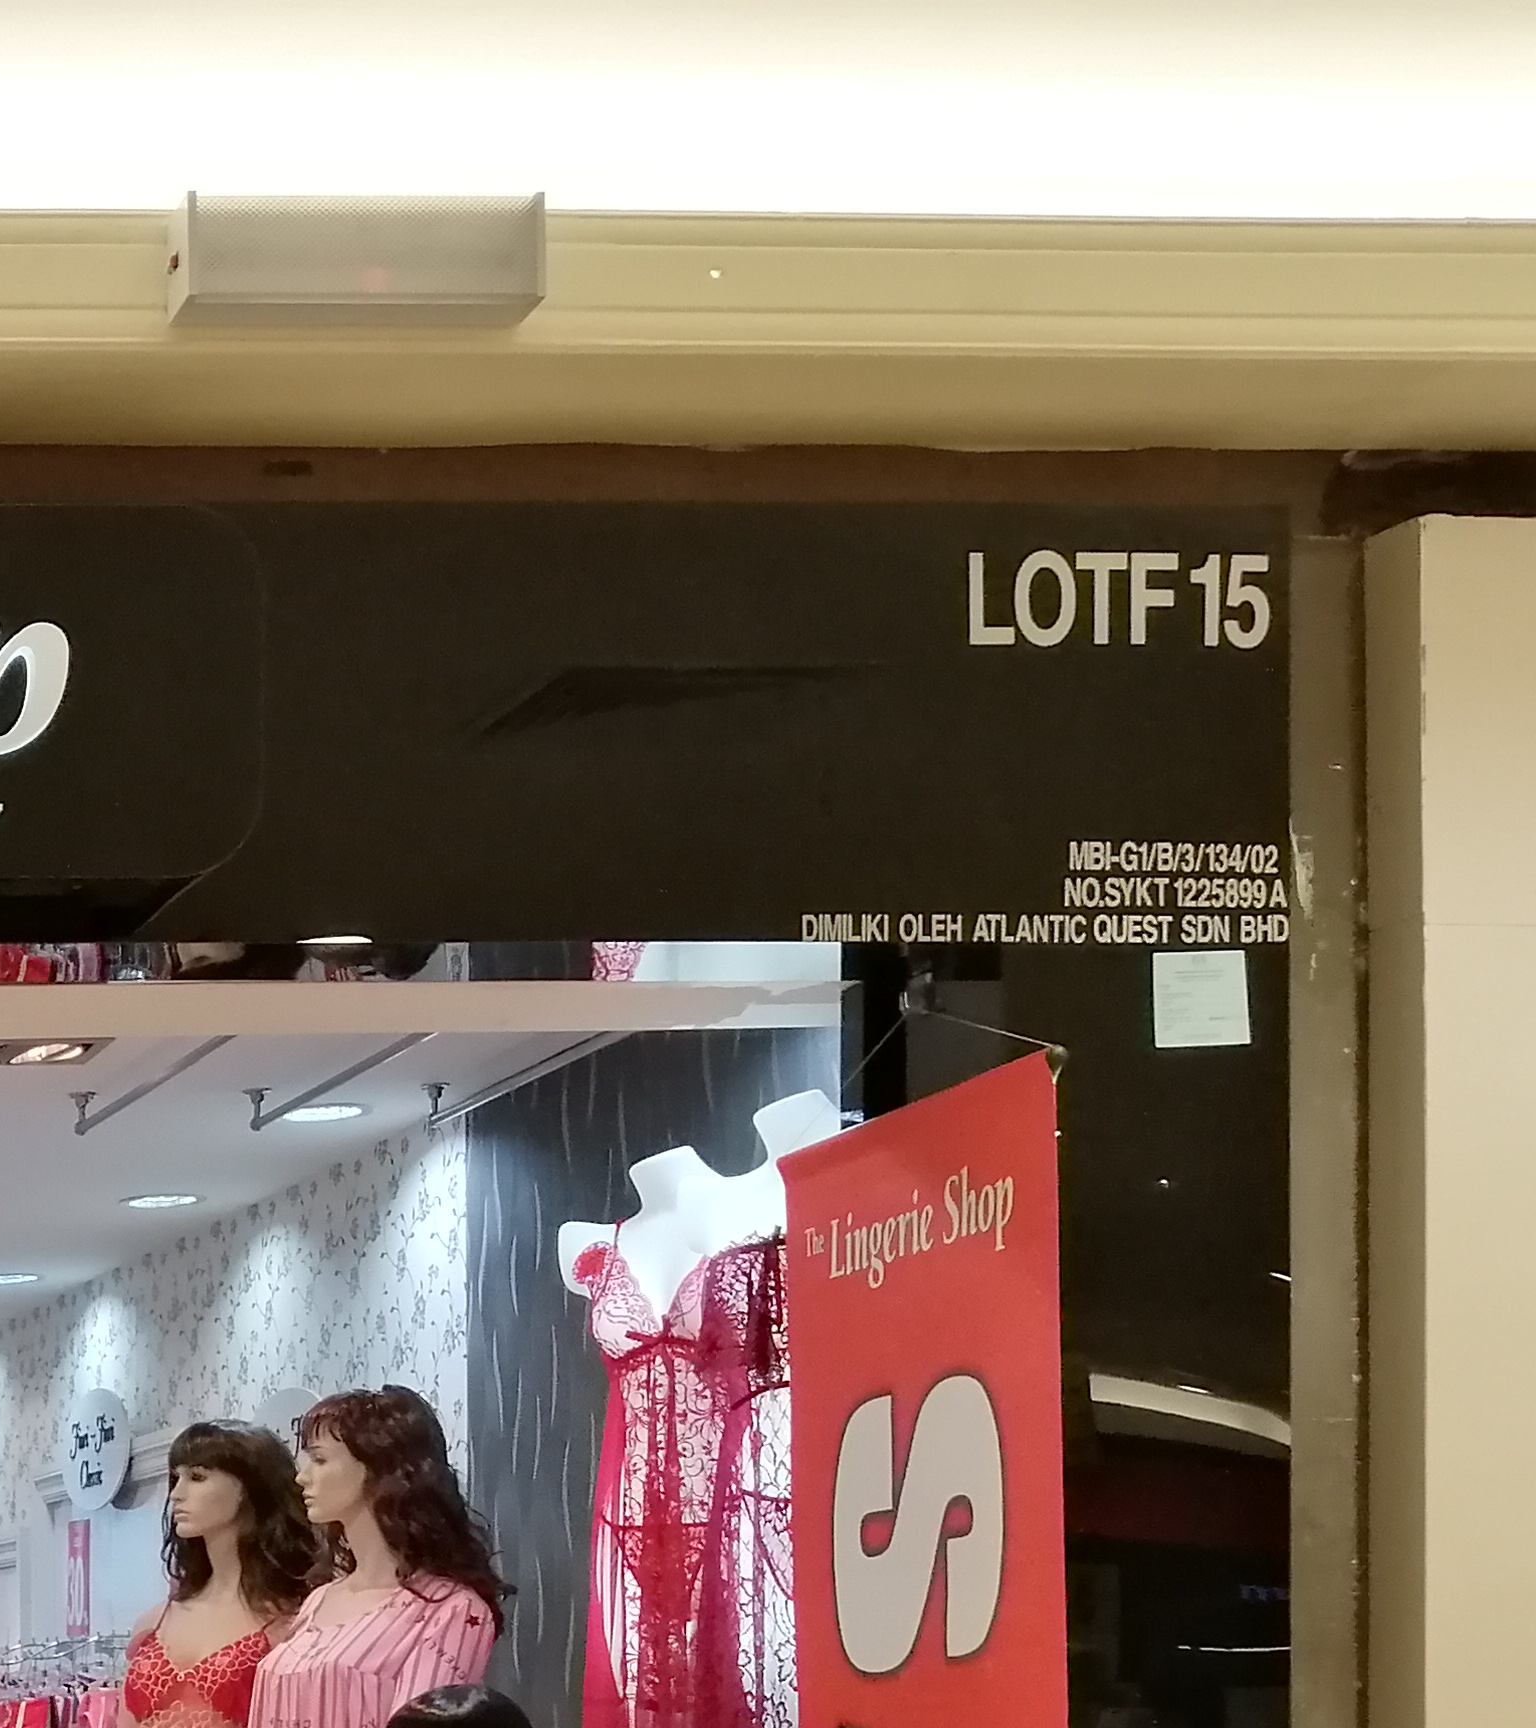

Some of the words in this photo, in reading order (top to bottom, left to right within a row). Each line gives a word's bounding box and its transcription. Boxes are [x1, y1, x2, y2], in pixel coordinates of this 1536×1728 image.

[1069, 841, 1279, 875] MBI-G1/B/3/134/02
[801, 914, 889, 943] DIMILIKI
[899, 914, 963, 943] OLEH
[973, 914, 1087, 943] ATLANTIC
[1093, 915, 1173, 944] QUEST
[1180, 915, 1231, 943] SDN
[1240, 915, 1289, 943] BHD
[804, 1227, 825, 1257] The
[829, 1188, 934, 1289] Lingerie
[942, 1165, 1014, 1251] Shop
